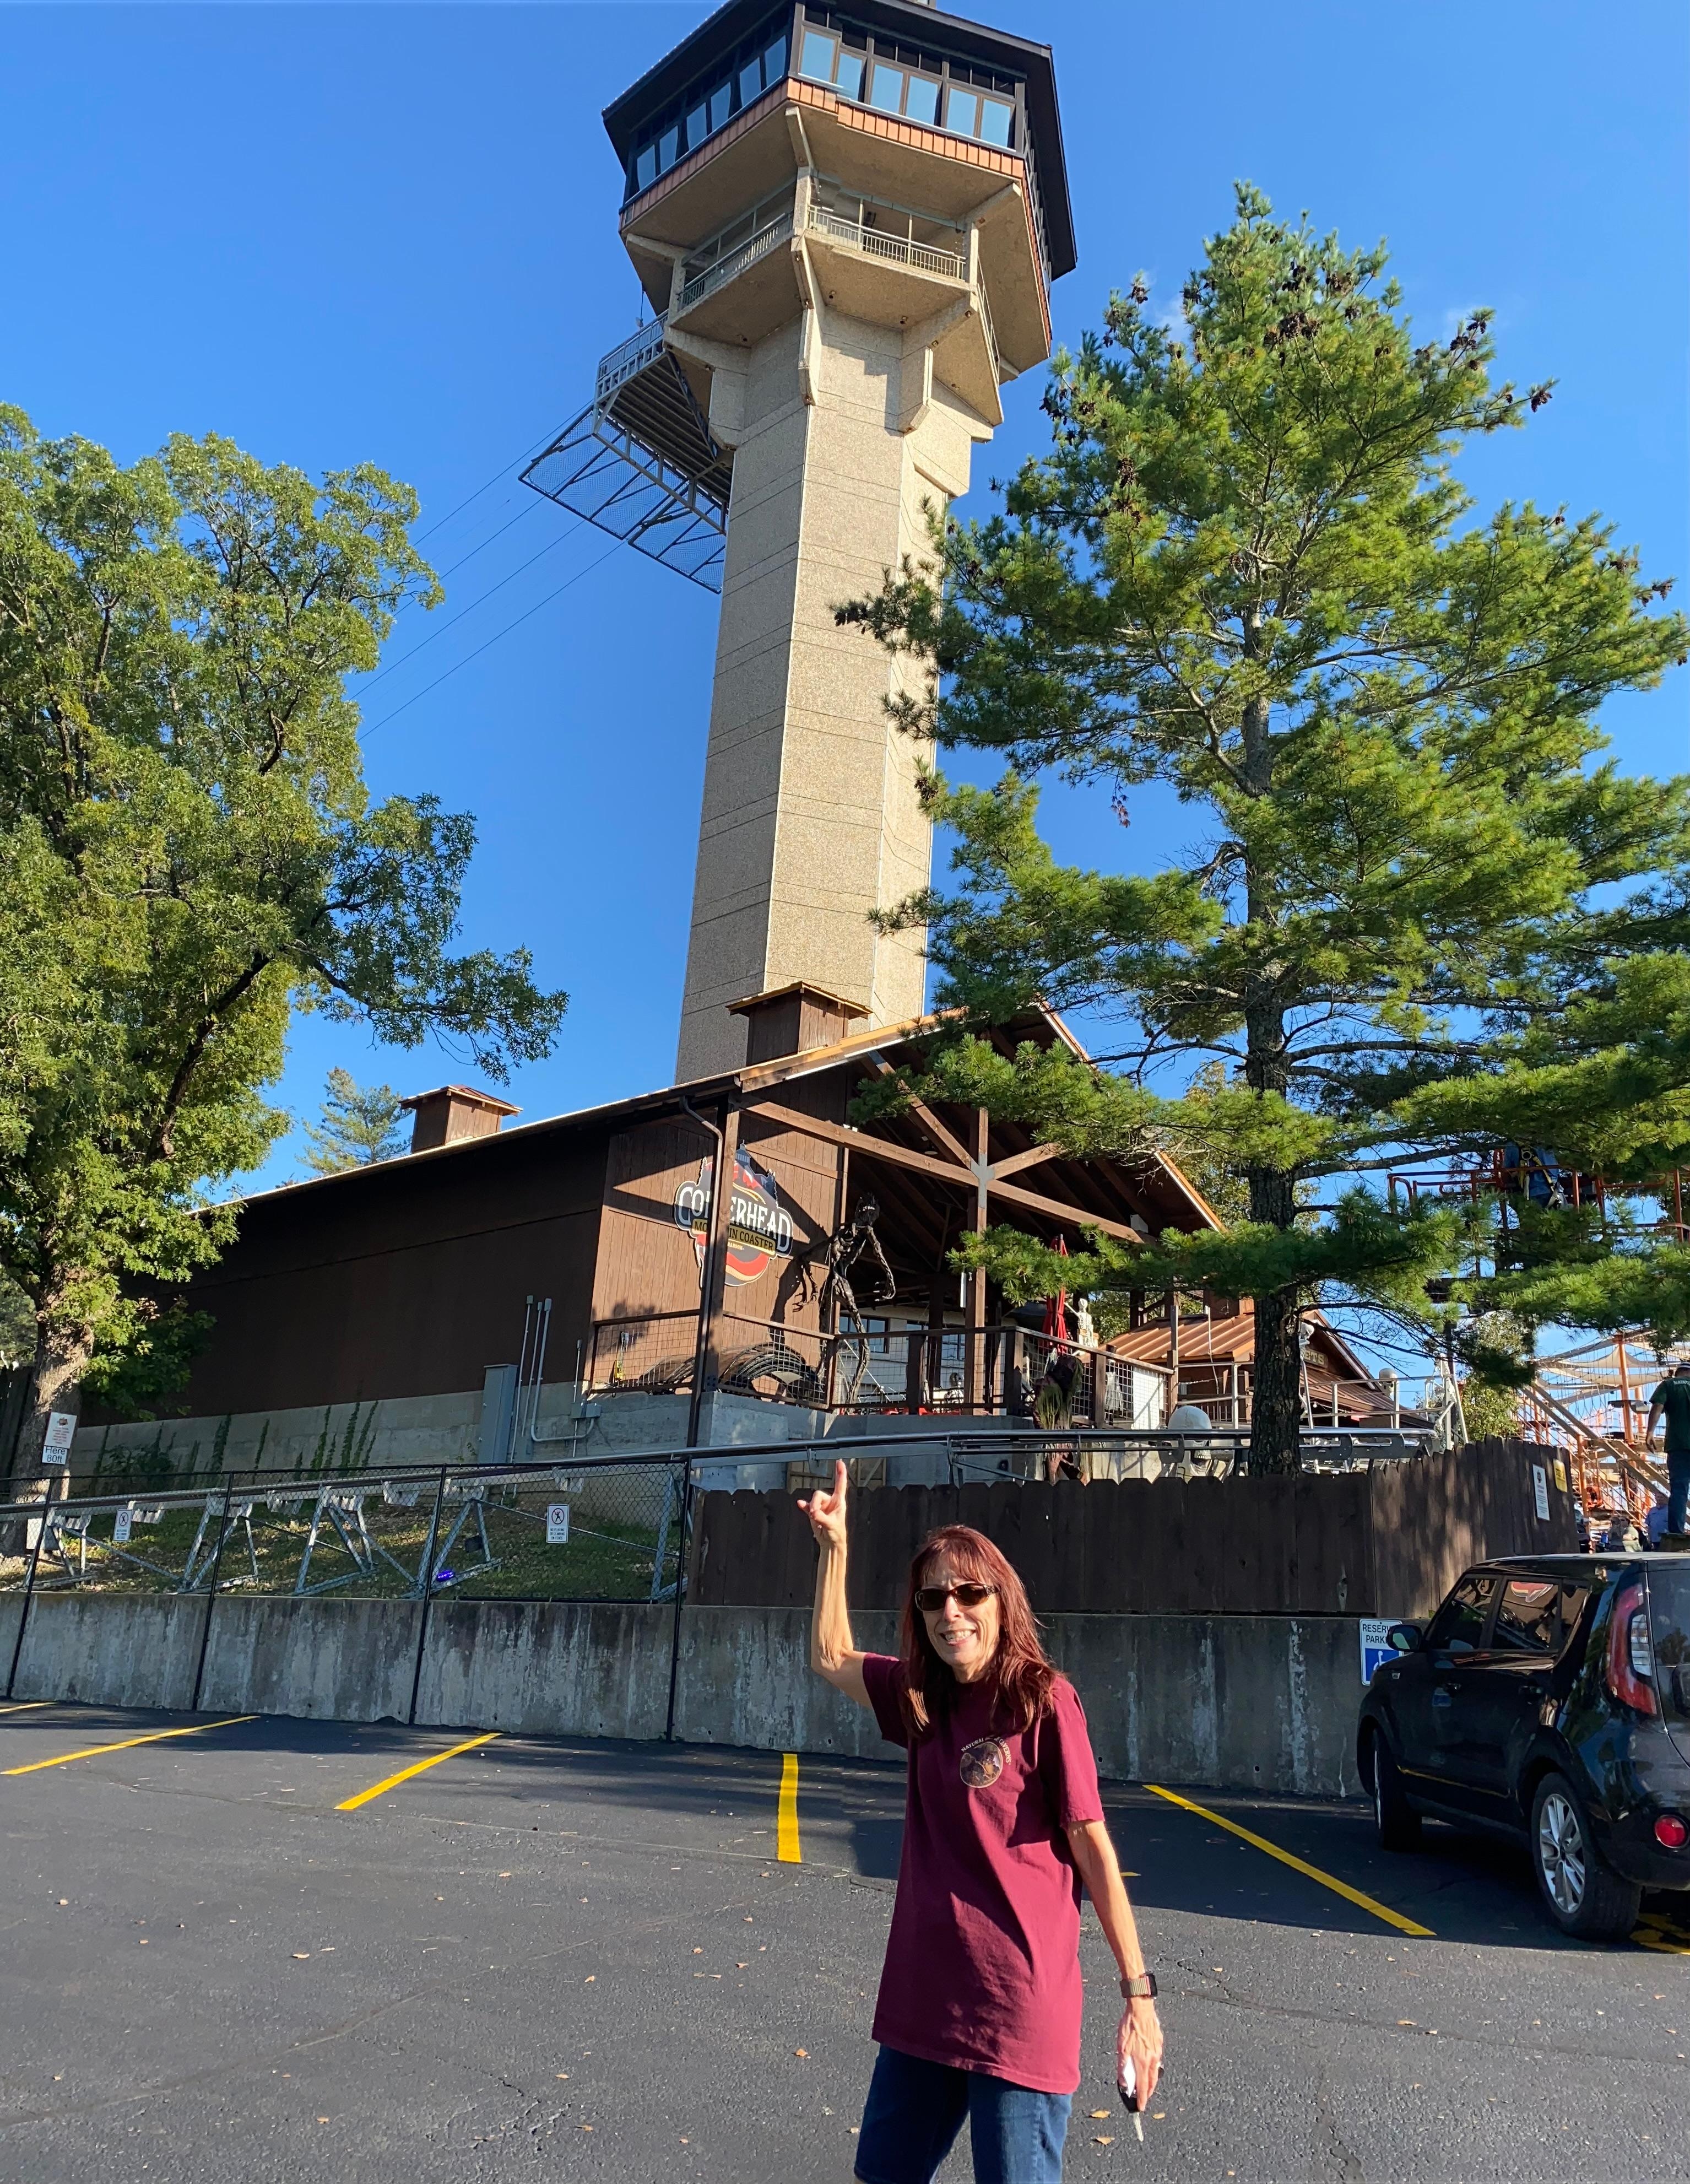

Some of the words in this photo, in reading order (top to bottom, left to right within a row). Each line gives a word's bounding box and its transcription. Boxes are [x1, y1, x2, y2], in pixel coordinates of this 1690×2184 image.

[678, 1186, 790, 1252] COERHEAD
[727, 1242, 743, 1250] RANSON
[739, 1231, 773, 1252] COASTER
[45, 1447, 66, 1455] Here
[46, 1455, 62, 1463] 80ft
[1362, 1624, 1390, 1633] RESERV
[961, 1738, 984, 1751] NATURAL
[999, 1738, 1011, 1763] CAVERNS
